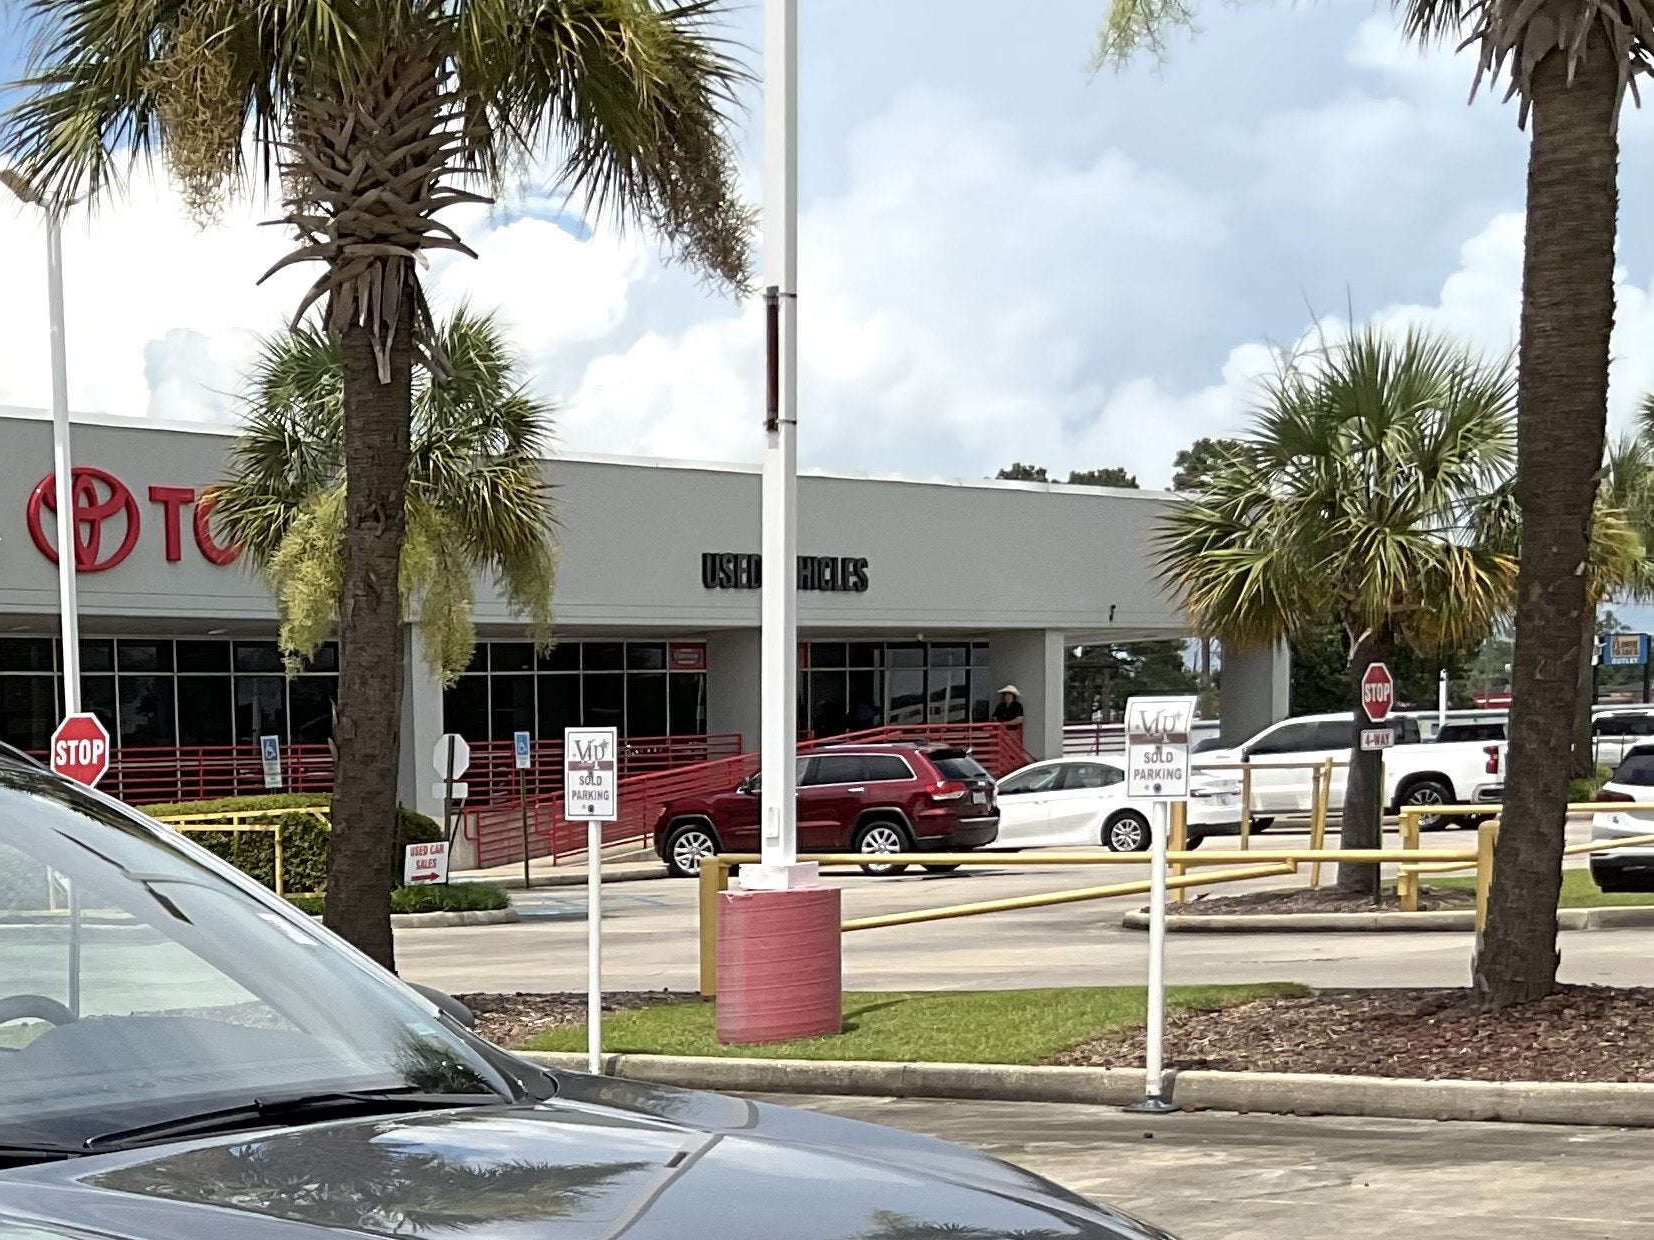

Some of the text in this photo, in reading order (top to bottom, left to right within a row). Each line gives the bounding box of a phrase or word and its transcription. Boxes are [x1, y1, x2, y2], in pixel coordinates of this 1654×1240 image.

[702, 553, 869, 592] USED HICLES
[1364, 682, 1390, 703] STOP
[1364, 732, 1390, 746] 4-WAY
[55, 739, 104, 766] STOP
[1143, 751, 1173, 763] SOLD
[1133, 768, 1182, 780] PARKING
[578, 775, 603, 786] SOLD
[571, 789, 610, 801] PARKING
[416, 858, 437, 870] SALES
